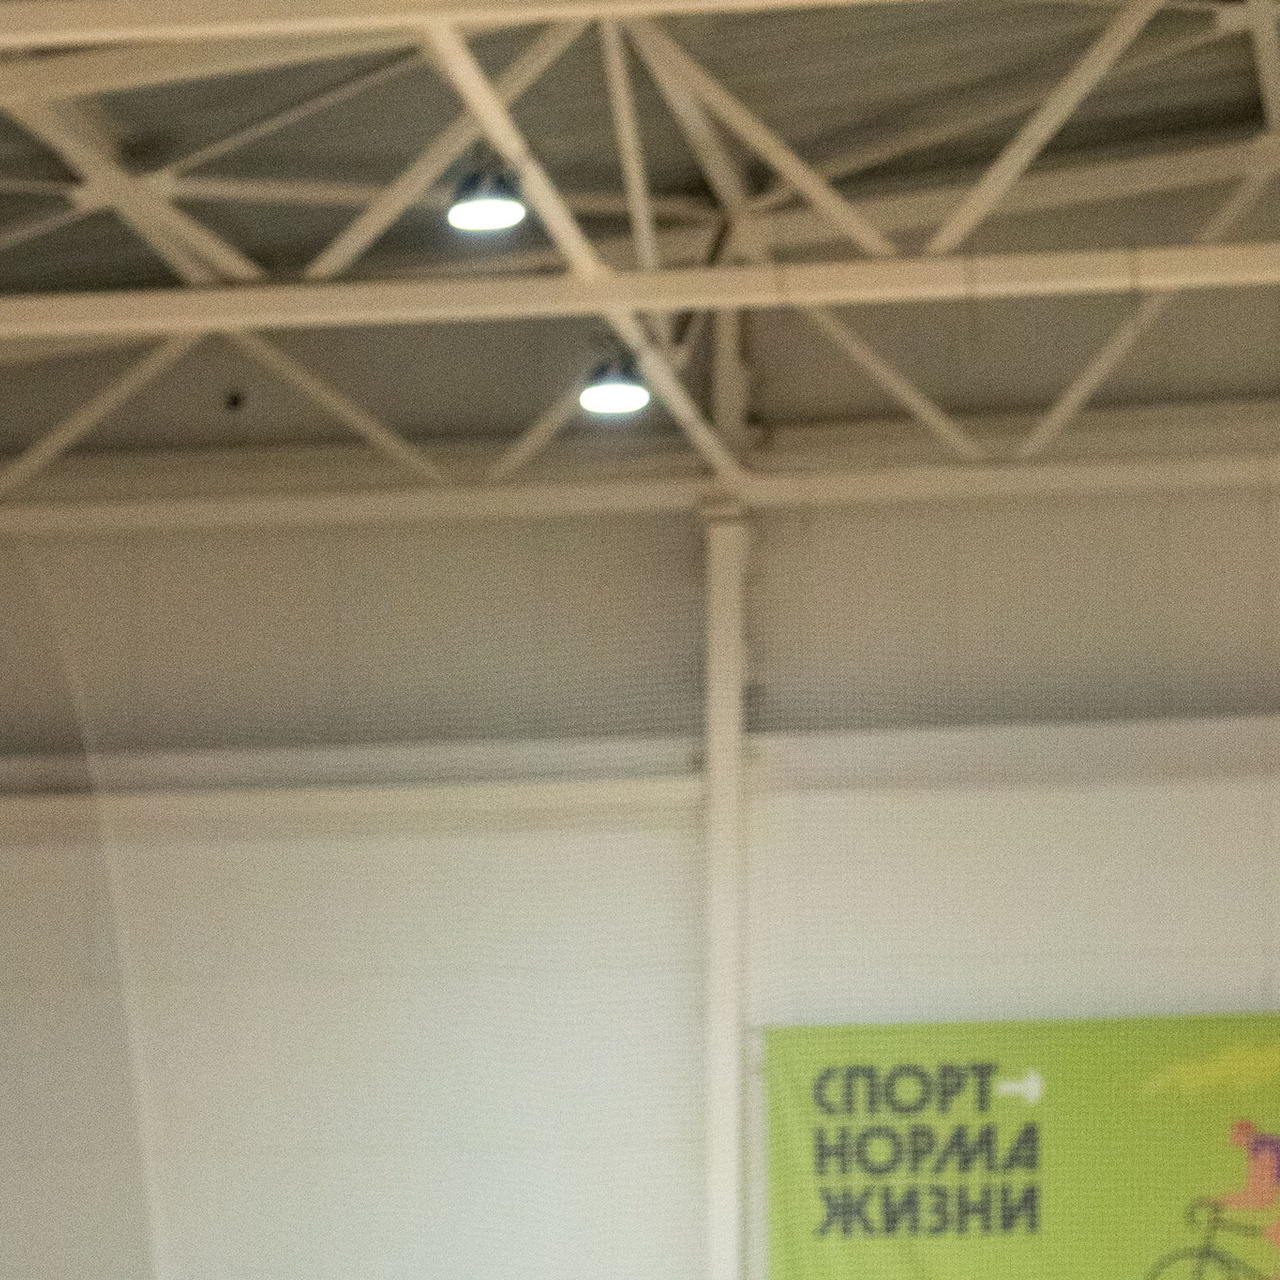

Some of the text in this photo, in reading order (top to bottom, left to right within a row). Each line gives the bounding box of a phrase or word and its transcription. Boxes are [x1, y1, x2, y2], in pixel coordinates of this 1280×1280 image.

[812, 1062, 997, 1115] СПОРТ
[812, 1121, 1039, 1176] НОРМА
[814, 1185, 1040, 1238] ЖИЗНИ
